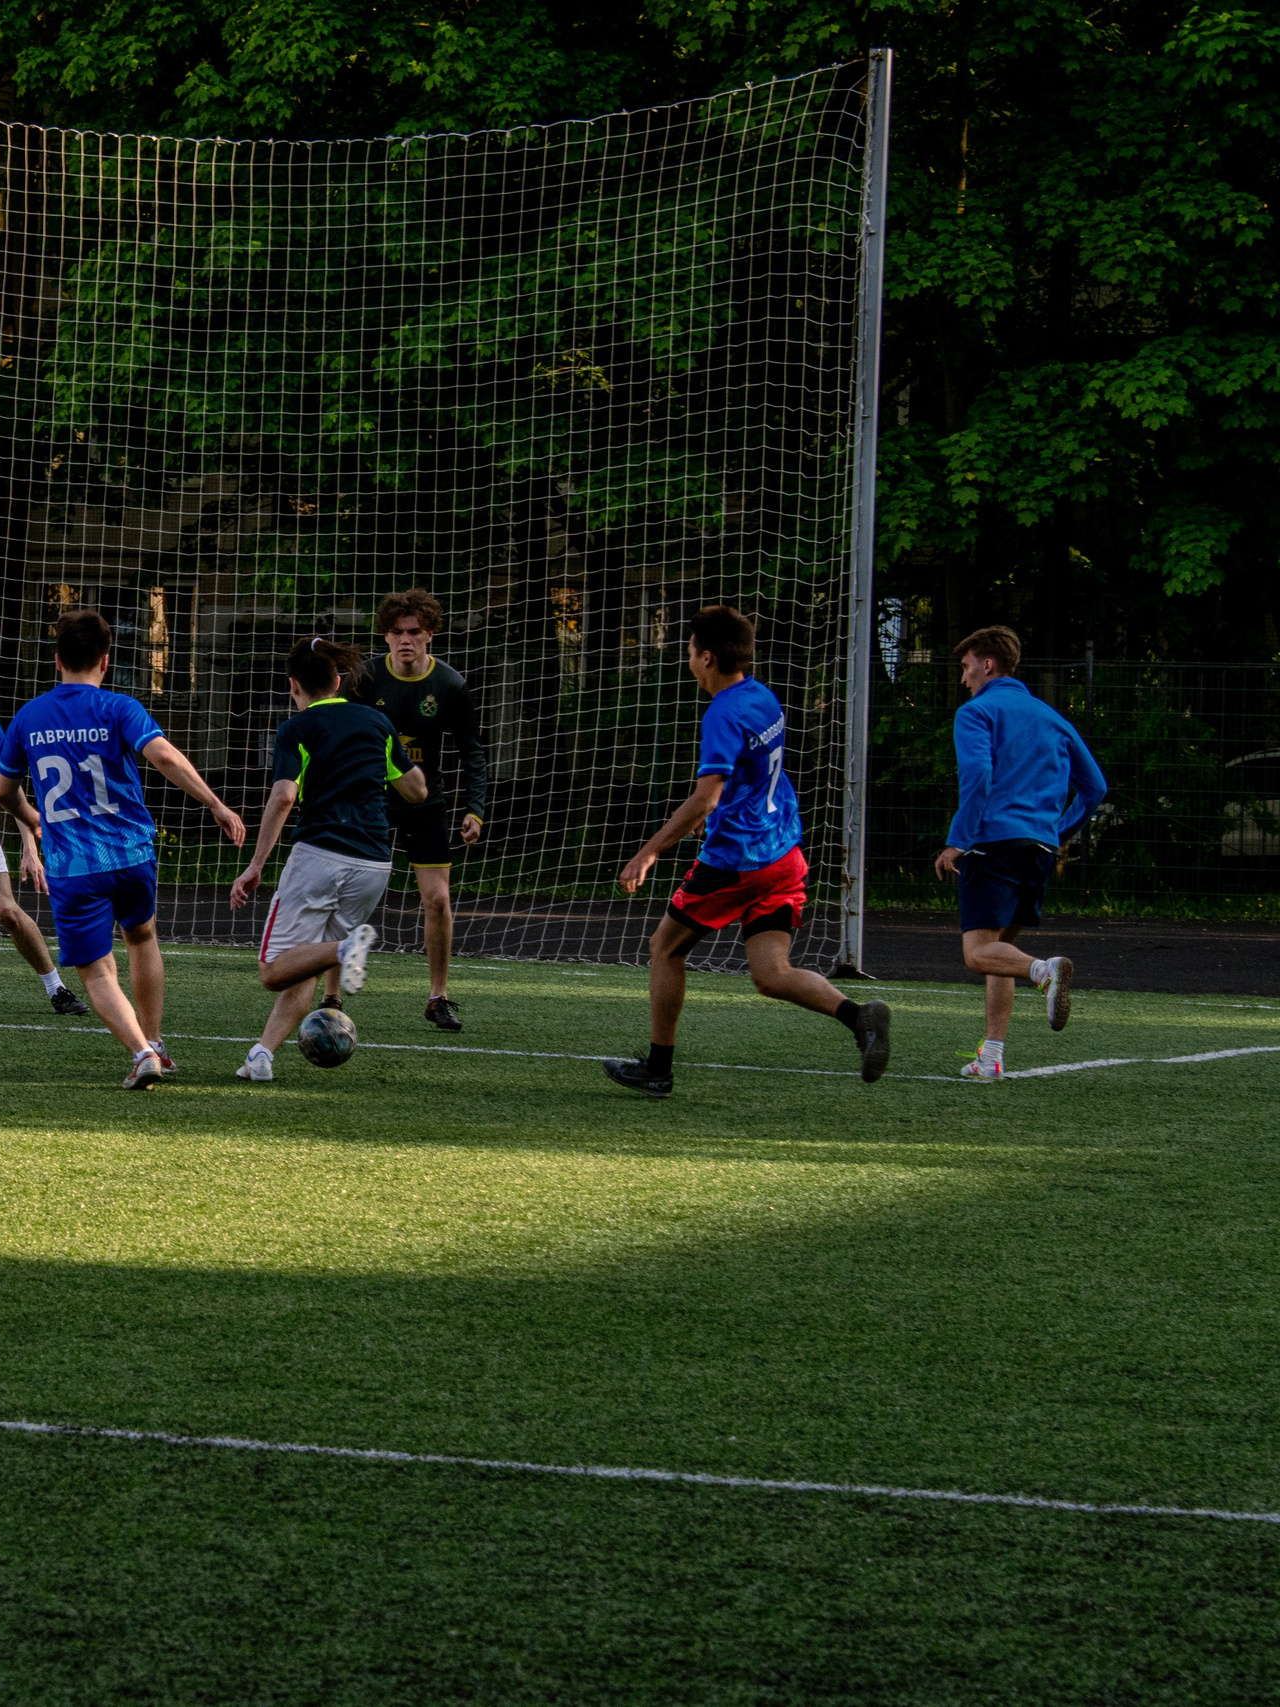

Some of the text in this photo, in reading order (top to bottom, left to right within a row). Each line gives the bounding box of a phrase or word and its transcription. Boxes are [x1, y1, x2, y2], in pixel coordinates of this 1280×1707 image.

[30, 728, 109, 746] ГАВРИЛОВ
[37, 754, 119, 823] 21
[767, 746, 782, 813] 7
